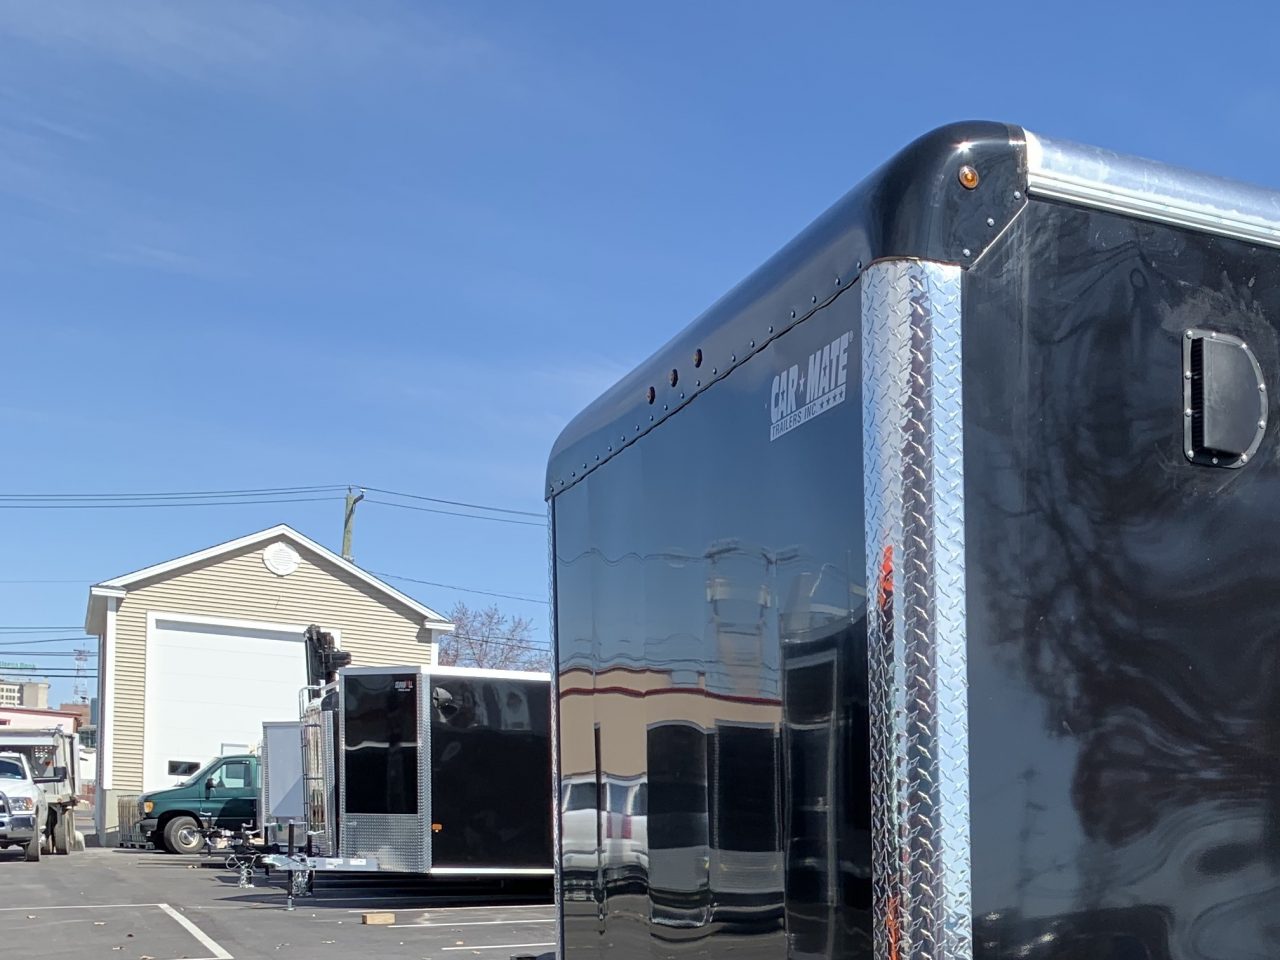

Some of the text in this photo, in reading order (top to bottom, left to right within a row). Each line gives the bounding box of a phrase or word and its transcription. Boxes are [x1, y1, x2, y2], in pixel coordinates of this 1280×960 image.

[770, 332, 850, 423] CAR MATE
[772, 411, 802, 438] TRAILERS
